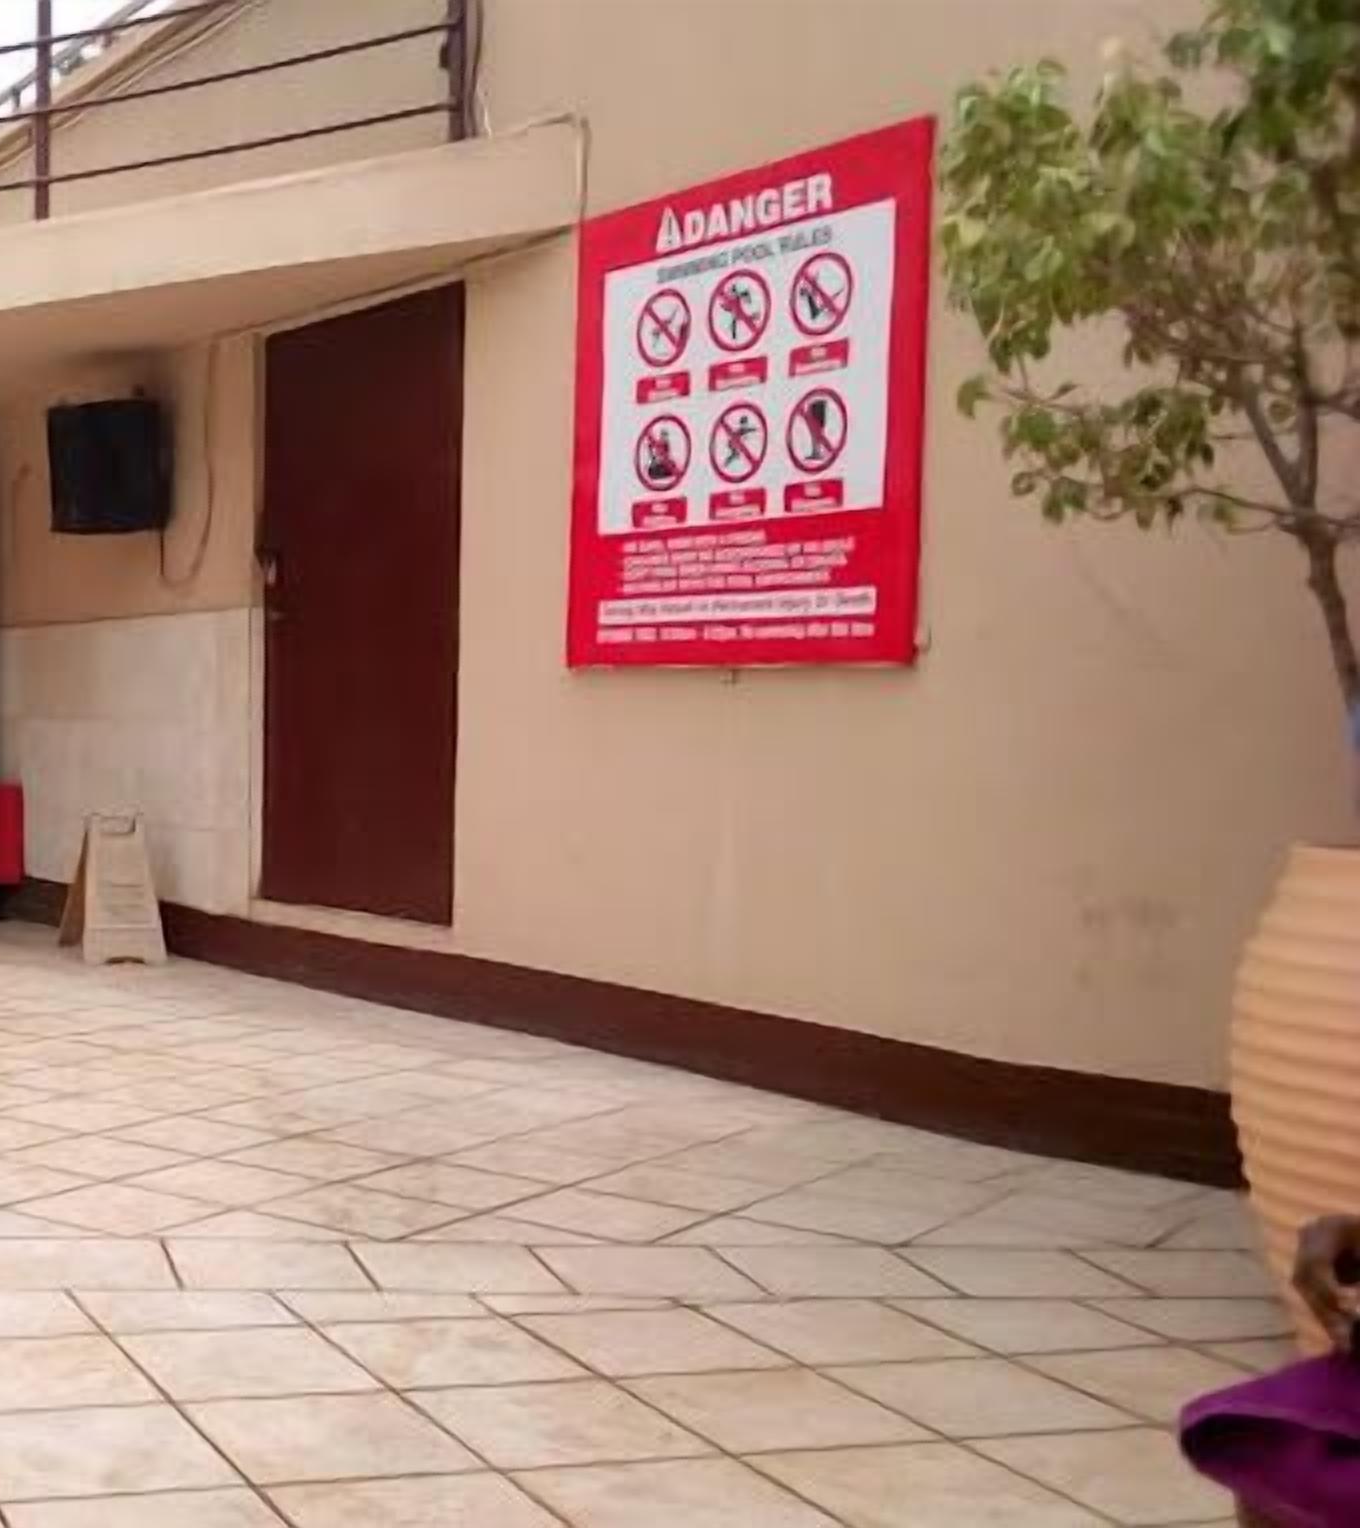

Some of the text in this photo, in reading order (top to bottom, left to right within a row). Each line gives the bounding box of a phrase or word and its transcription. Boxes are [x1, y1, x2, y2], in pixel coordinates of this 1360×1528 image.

[683, 172, 833, 245] DANGER
[731, 240, 775, 265] POOL
[779, 225, 833, 254] RULES
